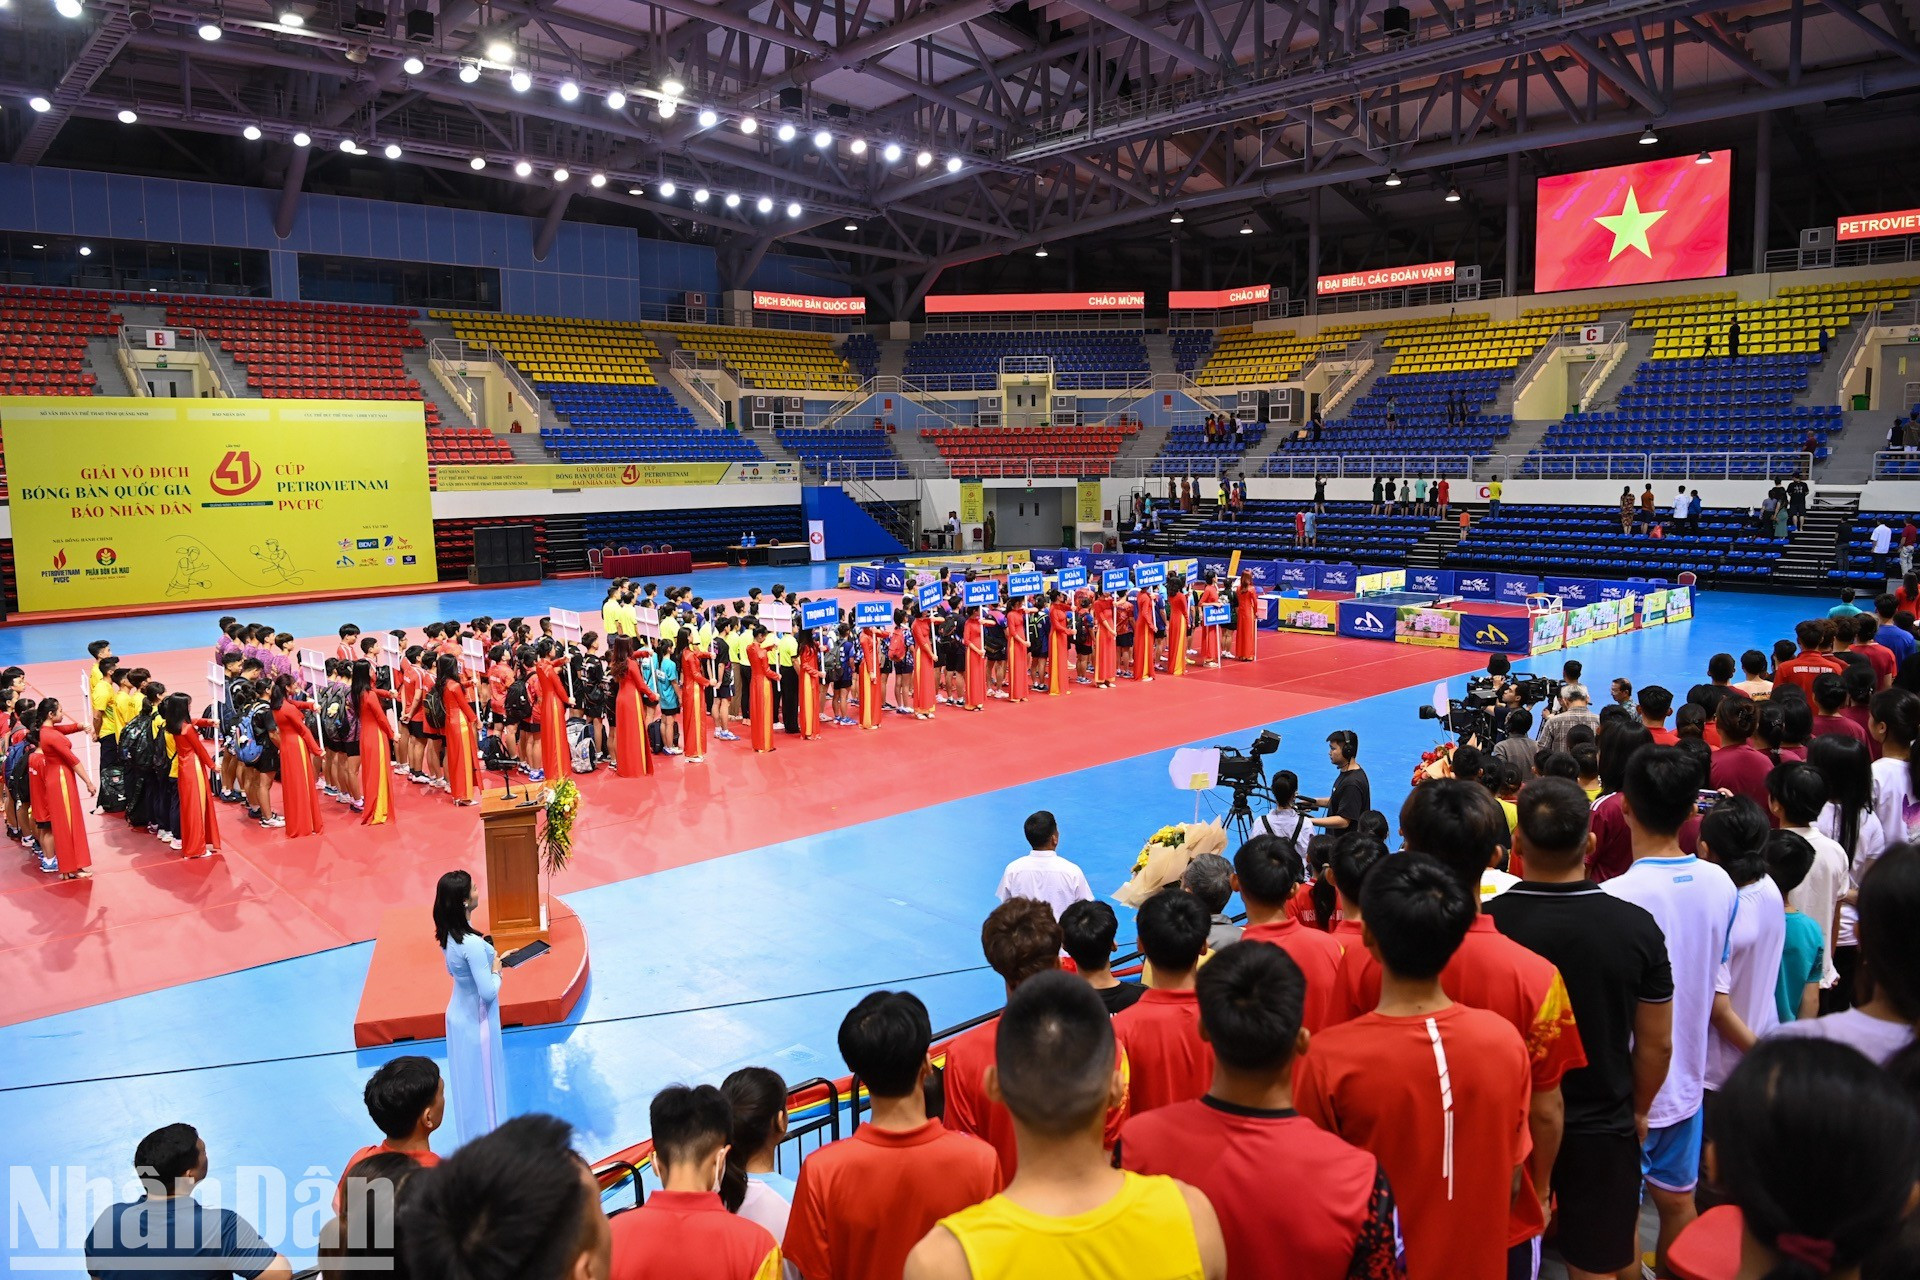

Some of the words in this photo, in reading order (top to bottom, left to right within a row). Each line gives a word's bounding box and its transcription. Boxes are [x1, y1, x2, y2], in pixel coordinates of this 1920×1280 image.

[1324, 279, 1339, 290] ĐẠI
[1368, 273, 1388, 284] CÁC
[1390, 269, 1418, 282] ĐOÀN
[1421, 267, 1441, 280] VẬN
[1088, 294, 1116, 305] CHÀO
[1230, 290, 1253, 302] CHÀO
[759, 296, 778, 307] ĐỊCH
[780, 297, 802, 307] BÓNG
[805, 299, 821, 309] BÀN
[823, 301, 847, 310] QUỐC
[1587, 329, 1597, 341] C
[80, 464, 116, 480] GIẢI
[121, 465, 144, 479] VÔ
[150, 467, 189, 482] ĐỊCH
[216, 451, 251, 484] 41
[275, 462, 305, 476] CÚP
[624, 465, 636, 479] 41
[22, 486, 69, 500] BÓNG
[76, 484, 109, 498] BÀN
[114, 481, 159, 499] QUỐC
[164, 485, 191, 496] GIA
[277, 480, 389, 492] PETROVIETNAM
[71, 505, 104, 518] BÁO
[110, 503, 154, 516] NHÂN
[161, 501, 192, 515] DÂN
[279, 499, 323, 511] PVCFC
[1064, 570, 1080, 579] ĐOÀN
[1109, 572, 1124, 580] ĐOÀN
[1142, 568, 1158, 576] ĐOÀN
[924, 586, 937, 597] ĐOÀN
[972, 584, 990, 593] ĐOÀN
[806, 609, 825, 620] TRỌNG
[826, 606, 835, 616] TÀI
[864, 604, 884, 613] ĐOÀN
